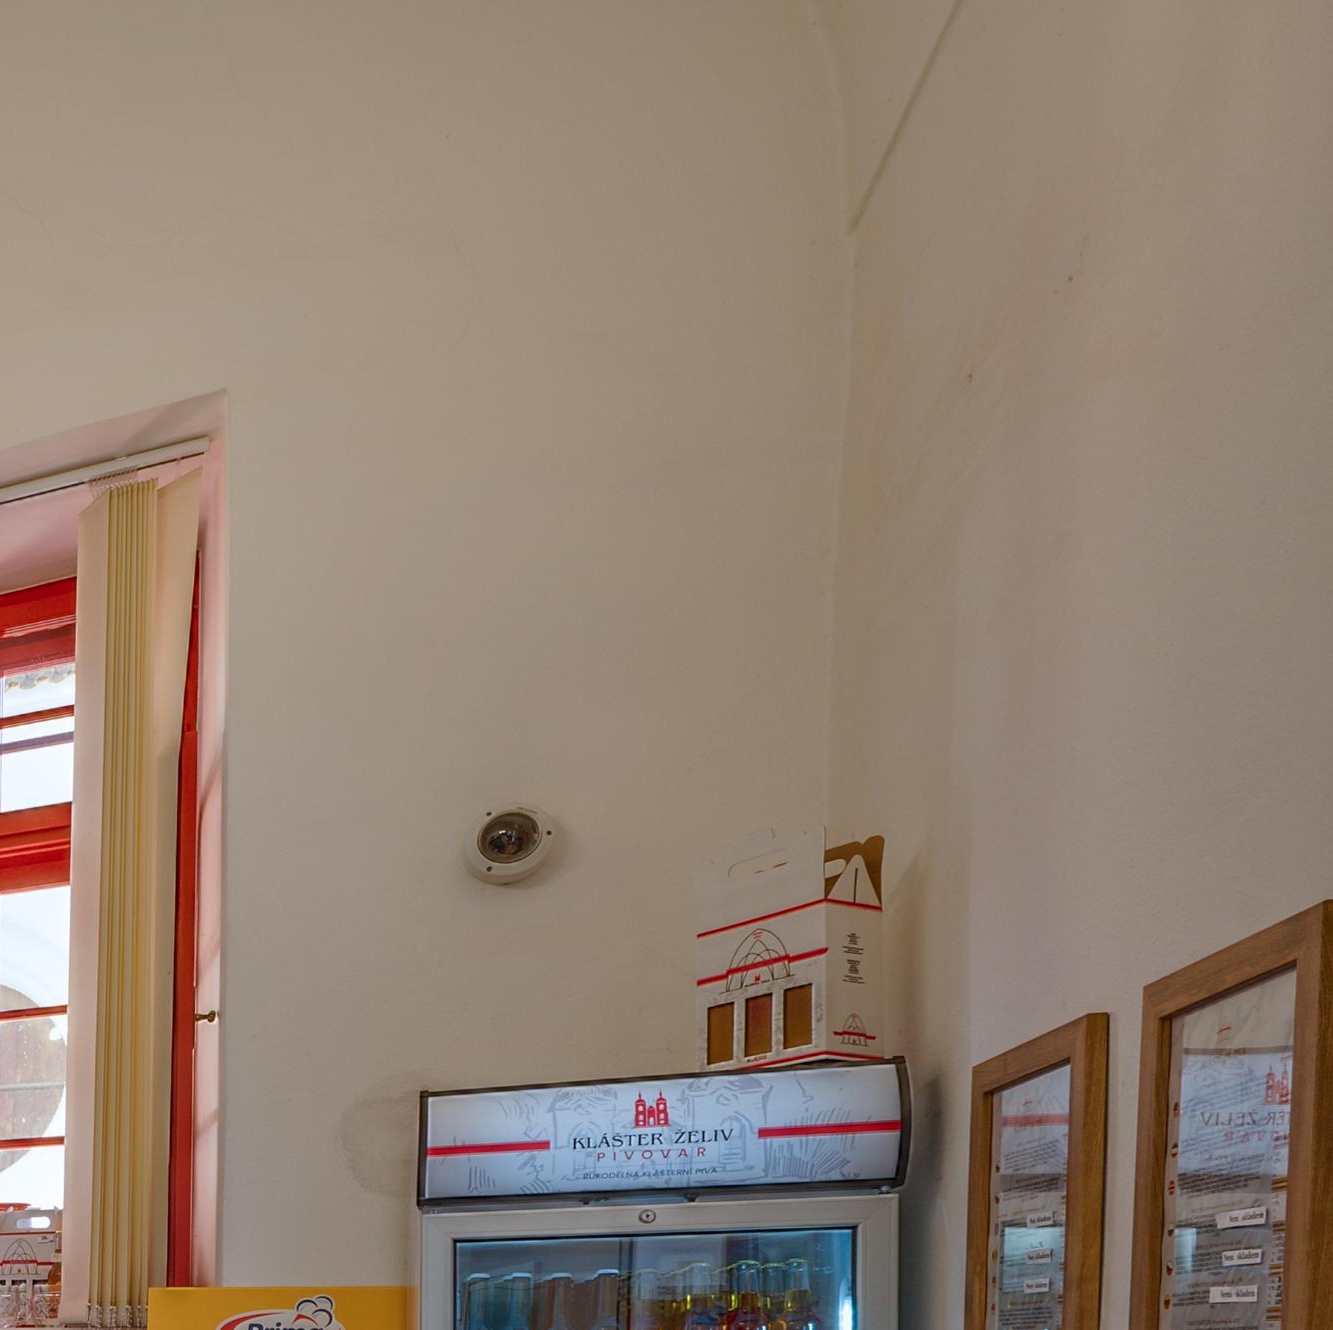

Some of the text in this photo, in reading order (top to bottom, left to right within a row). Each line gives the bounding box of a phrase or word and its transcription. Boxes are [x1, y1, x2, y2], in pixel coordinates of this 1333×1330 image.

[572, 1127, 734, 1150] KLÁŠTER ŽELIV
[597, 1147, 707, 1162] PIVOVAR
[695, 1166, 718, 1175] PIVA
